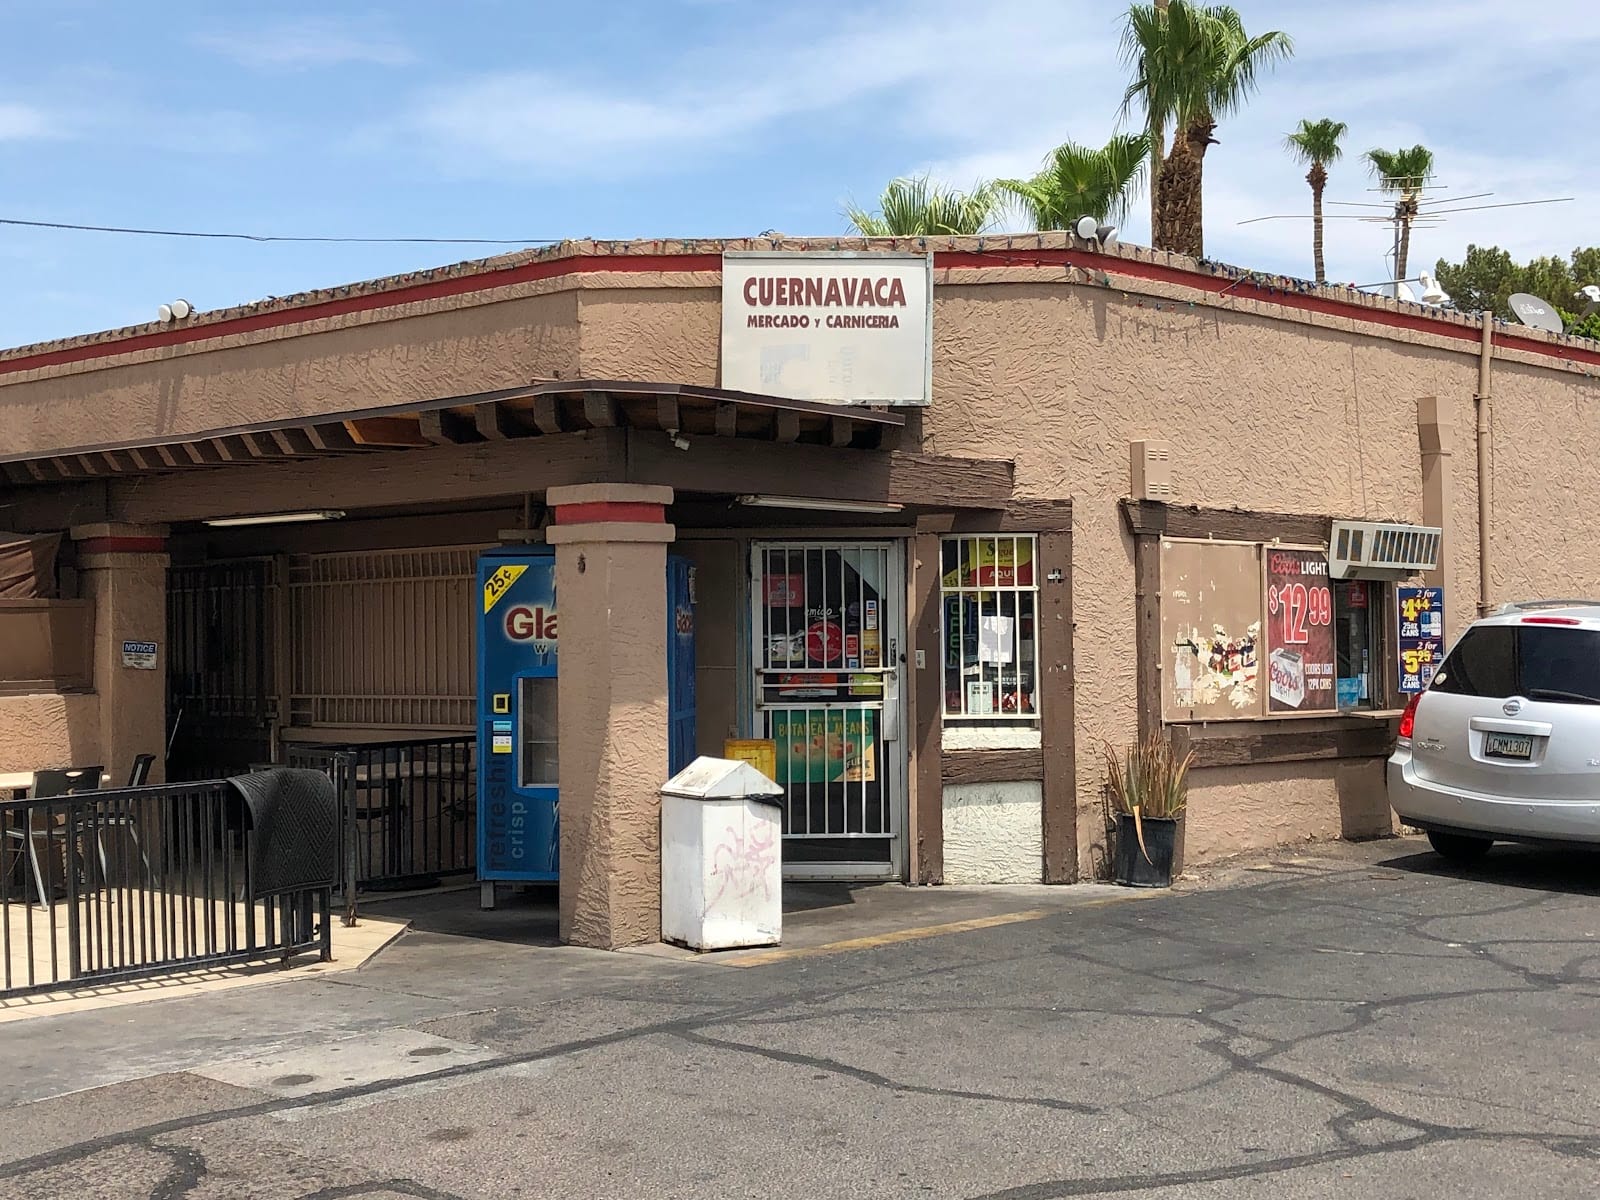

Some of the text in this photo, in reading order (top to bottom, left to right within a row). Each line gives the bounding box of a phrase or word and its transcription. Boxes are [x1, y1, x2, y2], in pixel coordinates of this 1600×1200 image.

[743, 277, 907, 307] CUERNAVACA
[747, 314, 810, 329] MERCADO
[826, 314, 900, 329] CARNICERIA
[1271, 553, 1327, 576] Coors LIGHT
[1416, 589, 1437, 599] 2 for
[125, 643, 155, 653] NOTICE
[1417, 641, 1438, 651] 2 for
[507, 801, 529, 860] crisp
